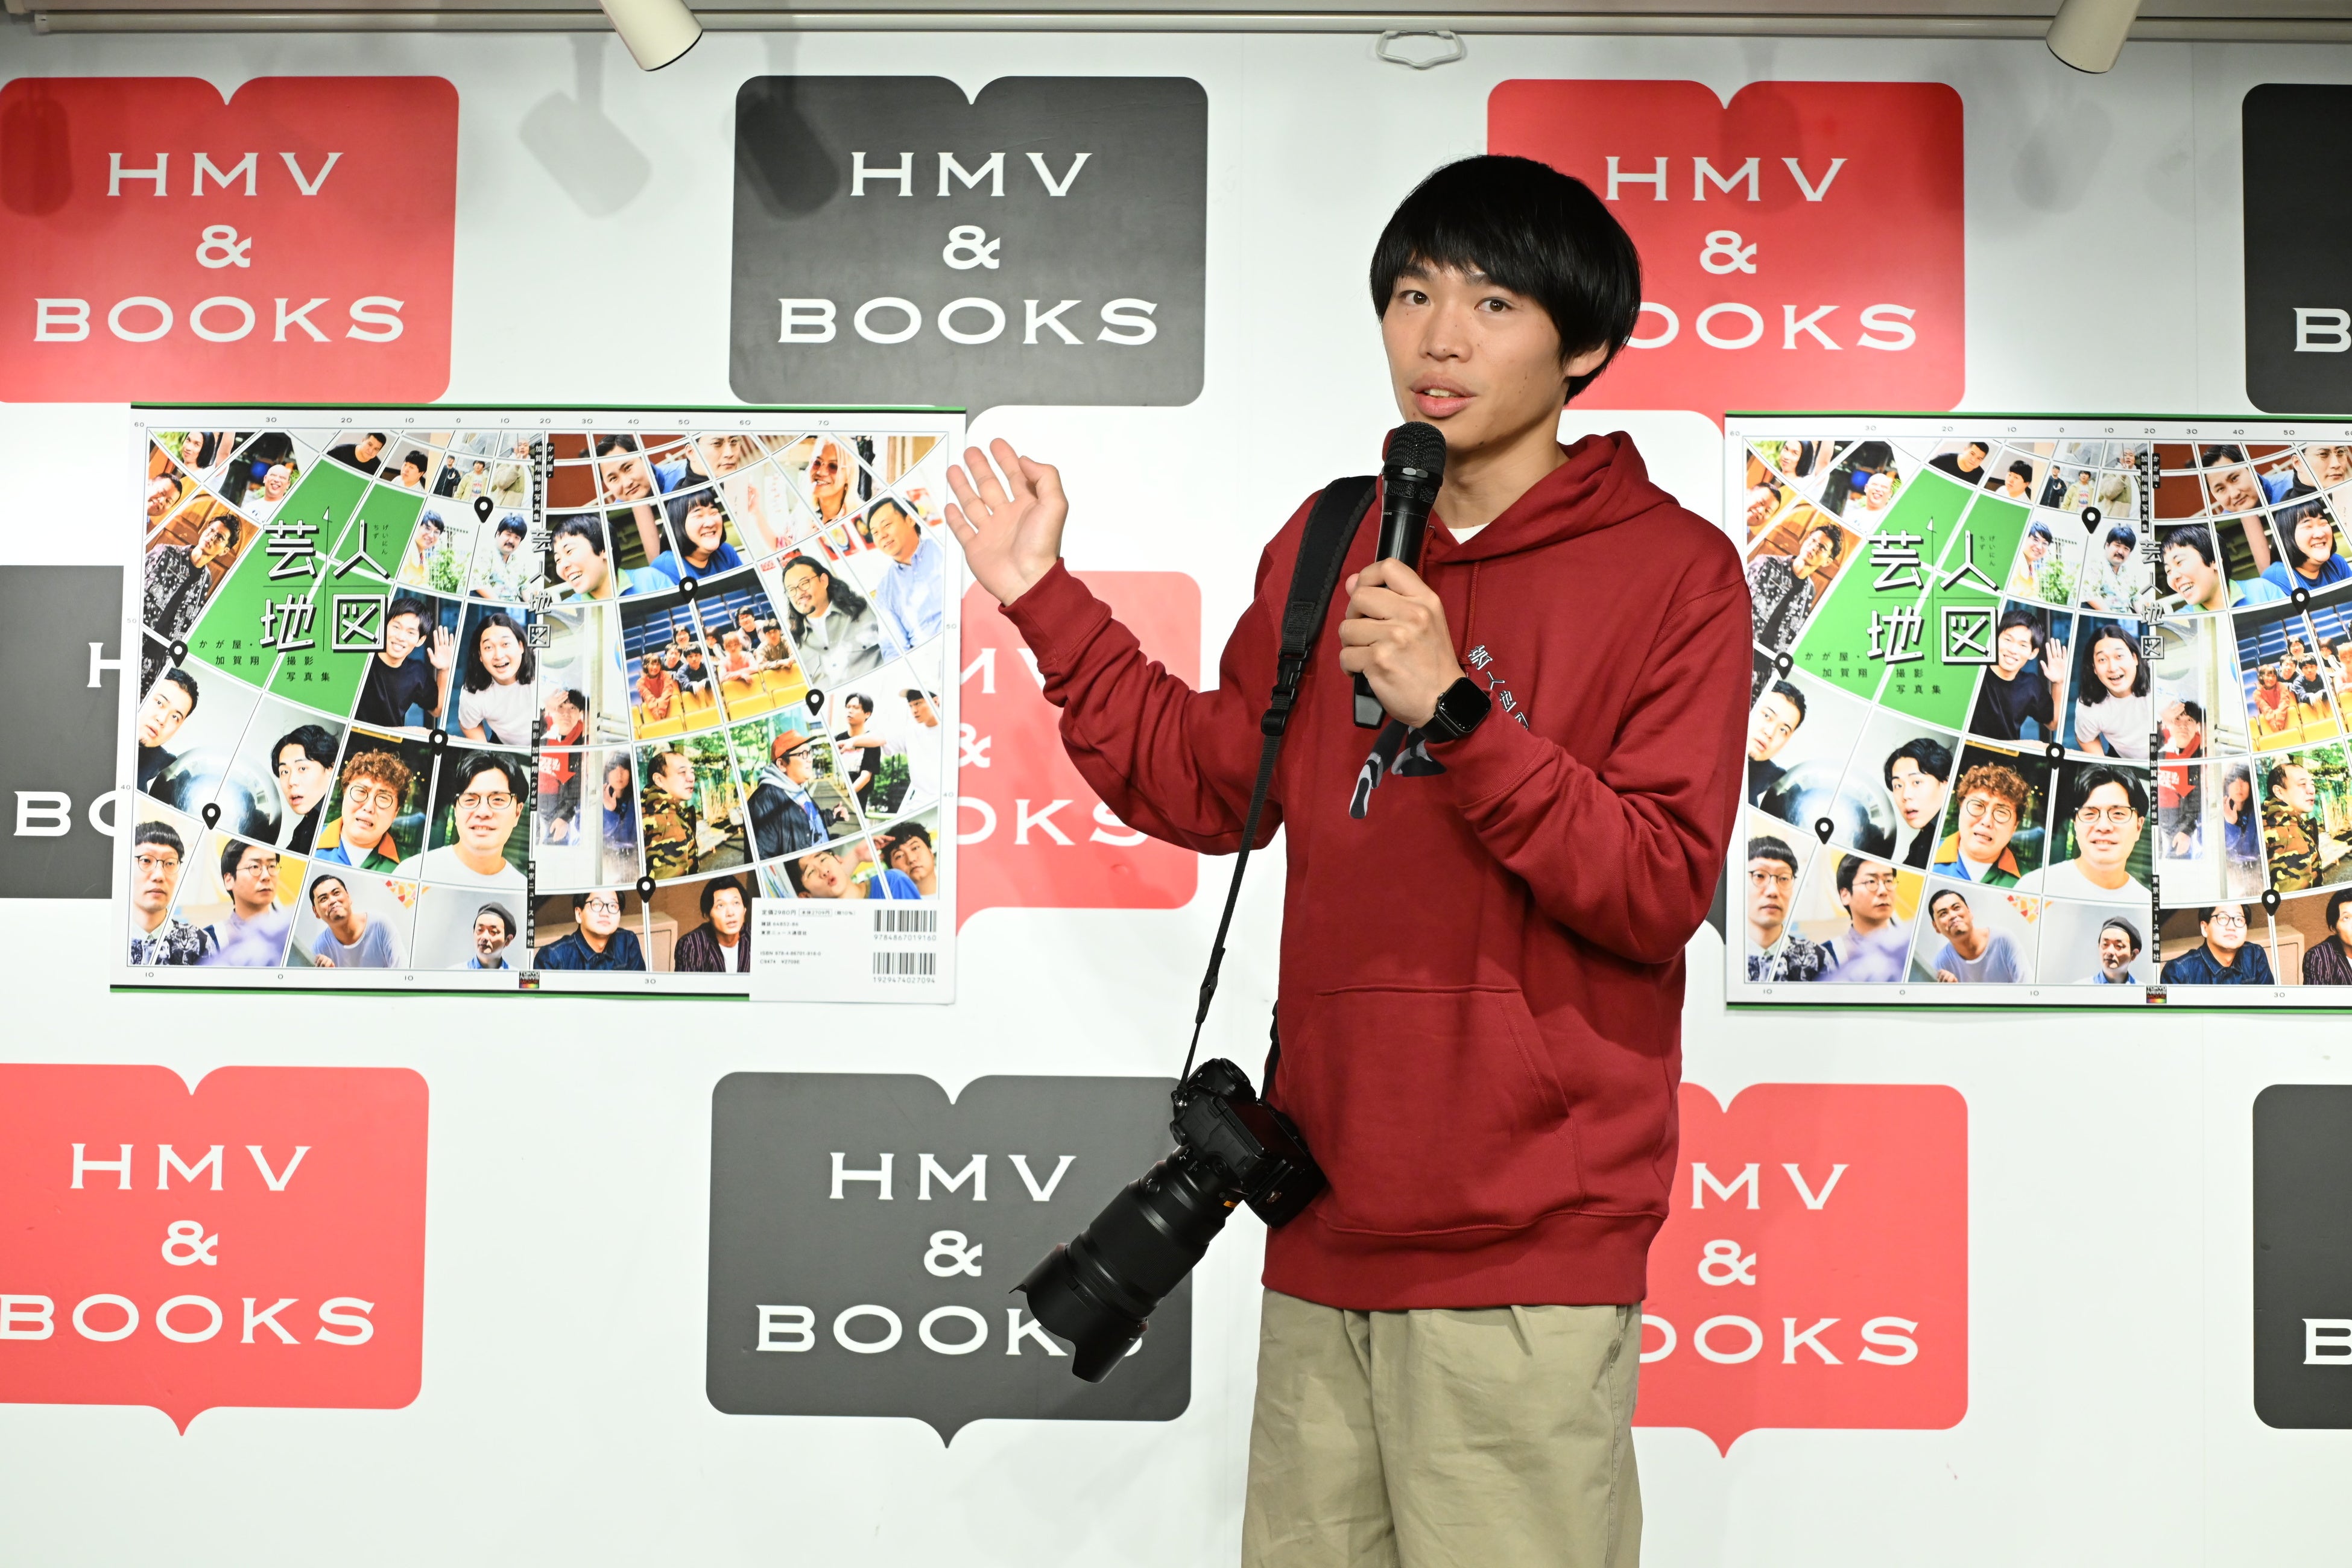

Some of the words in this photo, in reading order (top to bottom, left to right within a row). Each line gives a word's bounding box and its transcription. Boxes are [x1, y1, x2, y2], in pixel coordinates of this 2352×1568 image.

[107, 153, 343, 197] HMV
[850, 153, 1092, 197] HMV
[1605, 157, 1847, 201] HMV
[196, 225, 251, 268] &
[943, 226, 1001, 270] &
[1699, 230, 1757, 274] &
[33, 297, 405, 343] BOOKS
[778, 297, 1157, 345] BOOKS
[1626, 302, 1917, 351] OOKS
[264, 519, 390, 579] 芸人
[1867, 530, 1999, 592] 芸人
[527, 529, 552, 648] 芸人地図
[2139, 539, 2165, 660] 芸人地図
[259, 593, 386, 654] 地図
[1866, 605, 1999, 666] 地図
[215, 655, 259, 666] 加賀翔
[286, 656, 314, 666] 撮影
[286, 672, 330, 681] 写真集
[1822, 668, 1868, 678] 加賀翔
[1896, 668, 1923, 678] 撮影
[1896, 684, 1941, 694] 写真集
[71, 1143, 311, 1191] HMV
[829, 1152, 1076, 1201] HMV
[1692, 1163, 1849, 1210] MV
[161, 1221, 218, 1266] &
[924, 1231, 982, 1277] &
[1698, 1240, 1756, 1286] &
[0, 1294, 375, 1345] BOOKS
[756, 1304, 1142, 1357] BOOK
[1640, 1314, 1919, 1365] OOKS
